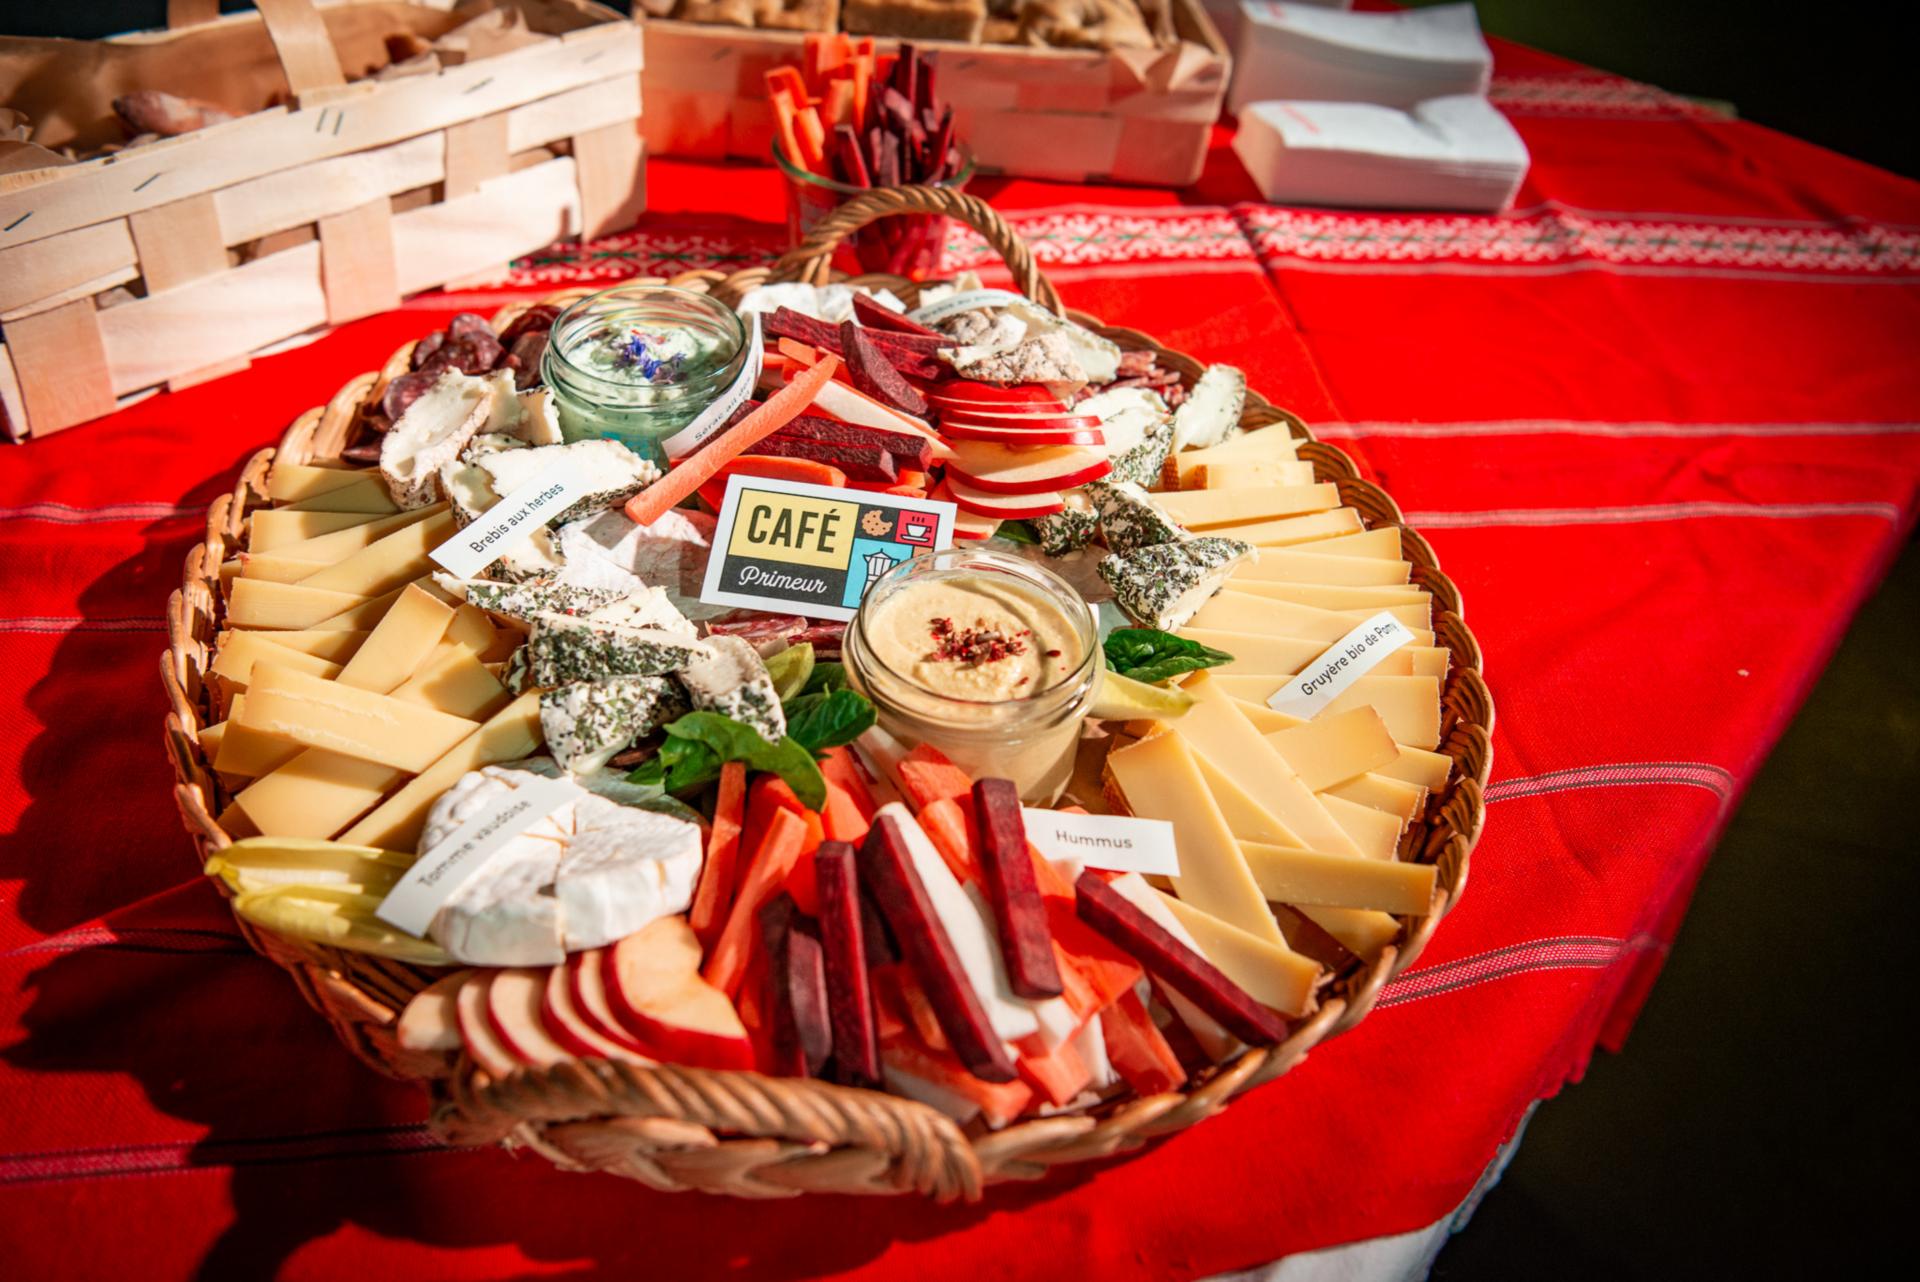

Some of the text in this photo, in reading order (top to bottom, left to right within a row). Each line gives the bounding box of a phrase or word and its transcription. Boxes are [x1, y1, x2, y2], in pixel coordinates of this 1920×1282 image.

[470, 483, 565, 553] Brebis aux herbes
[747, 504, 841, 553] CAFÉ
[738, 565, 828, 594] Primeur
[1300, 657, 1349, 696] Gruyère
[1345, 643, 1366, 660] bio
[1365, 633, 1379, 646] de
[417, 799, 532, 887] Tomme vaudoise
[1055, 829, 1133, 849] Hummus
